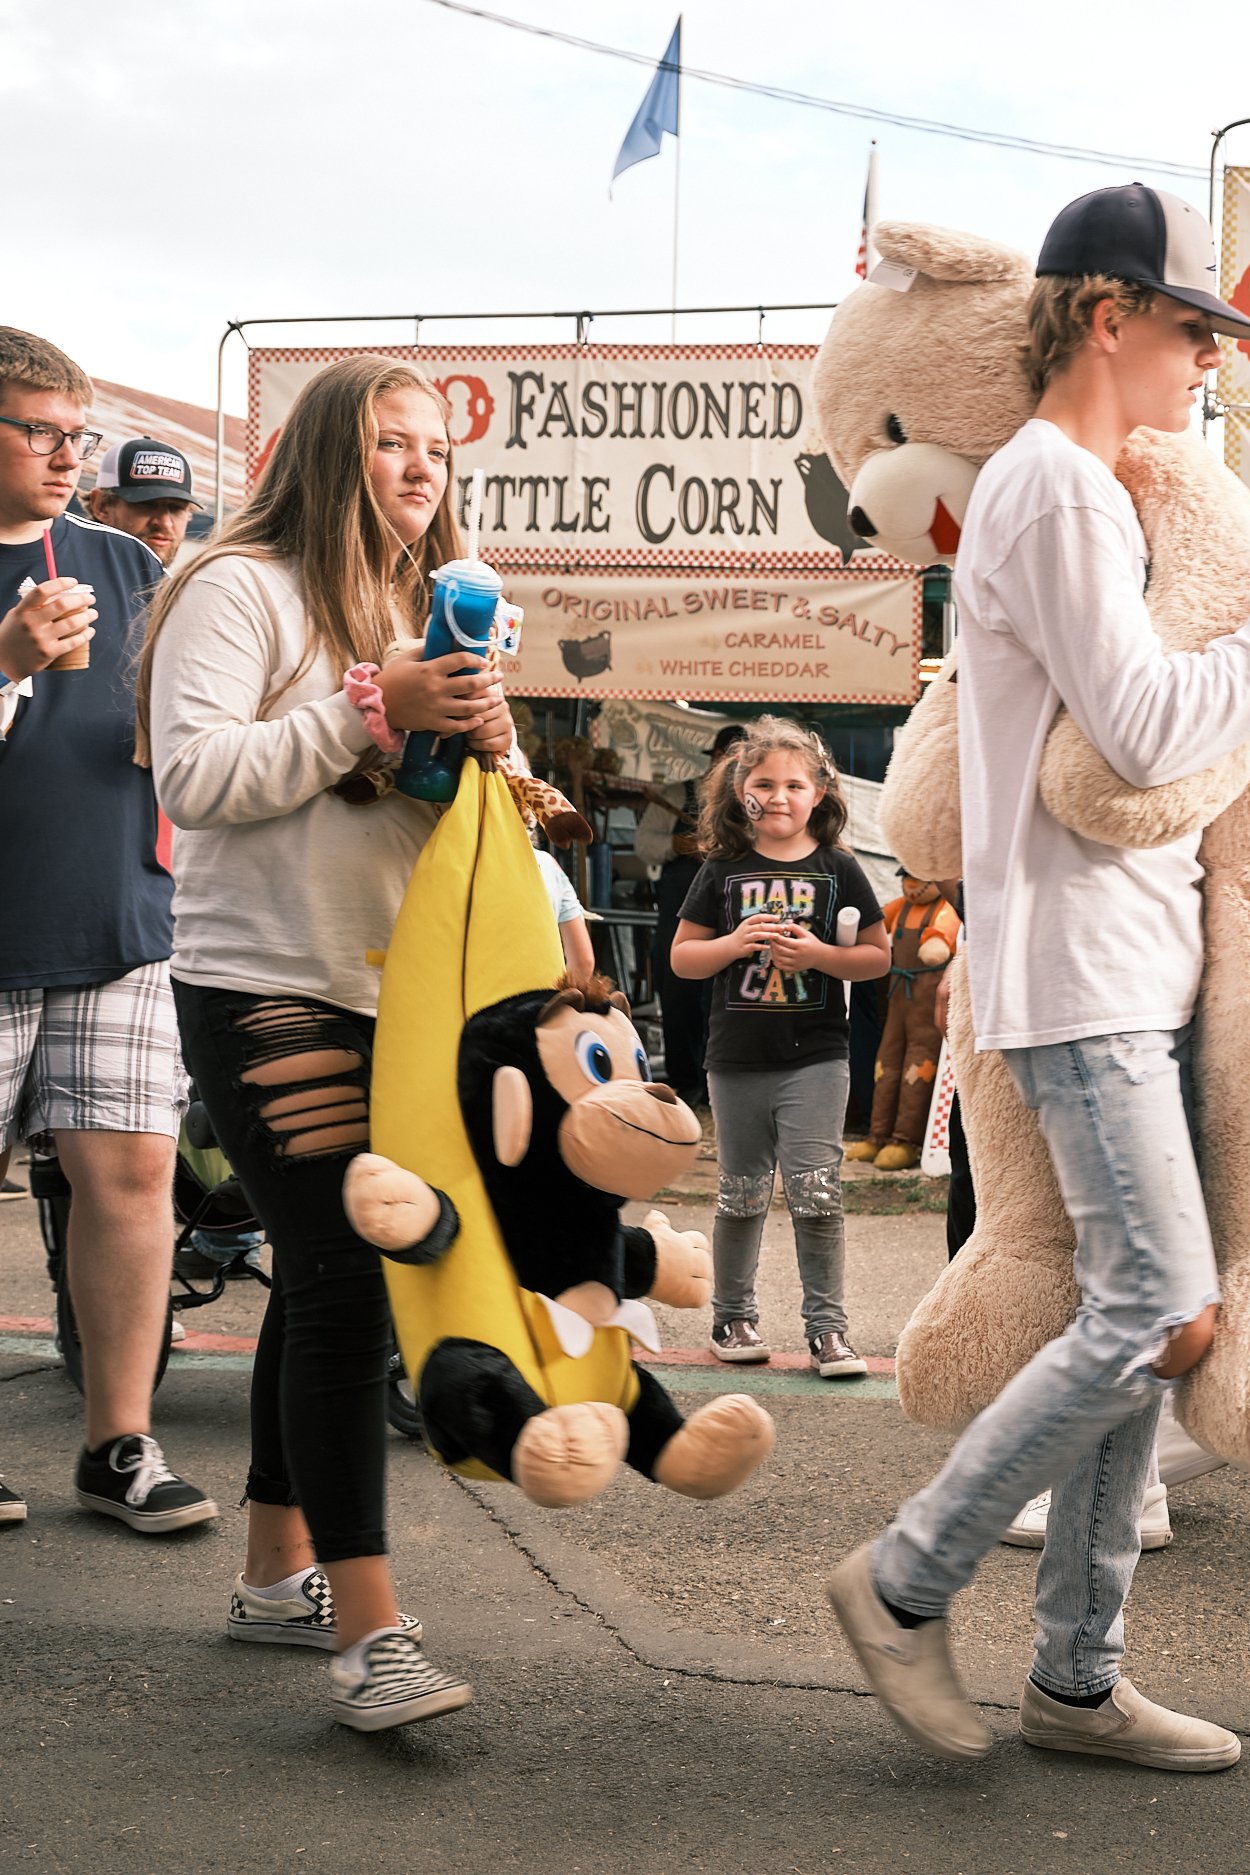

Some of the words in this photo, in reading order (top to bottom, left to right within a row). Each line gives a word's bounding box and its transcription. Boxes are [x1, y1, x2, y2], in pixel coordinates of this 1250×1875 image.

[505, 371, 802, 449] FASHIONED
[137, 455, 181, 470] AMERICAN
[137, 465, 157, 475] TOP
[158, 466, 180, 478] TEAM
[457, 475, 609, 532] ETTLE
[637, 464, 783, 544] CORN
[542, 588, 678, 622] ORIGINAL
[684, 588, 788, 613] SWEET
[790, 599, 811, 619] &
[818, 606, 910, 658] SALTY
[725, 632, 825, 649] CARAMEL
[661, 660, 723, 677] WHITE
[729, 660, 830, 678] CHEDDAR
[740, 879, 816, 919] DAB
[739, 965, 808, 1003] CAT
